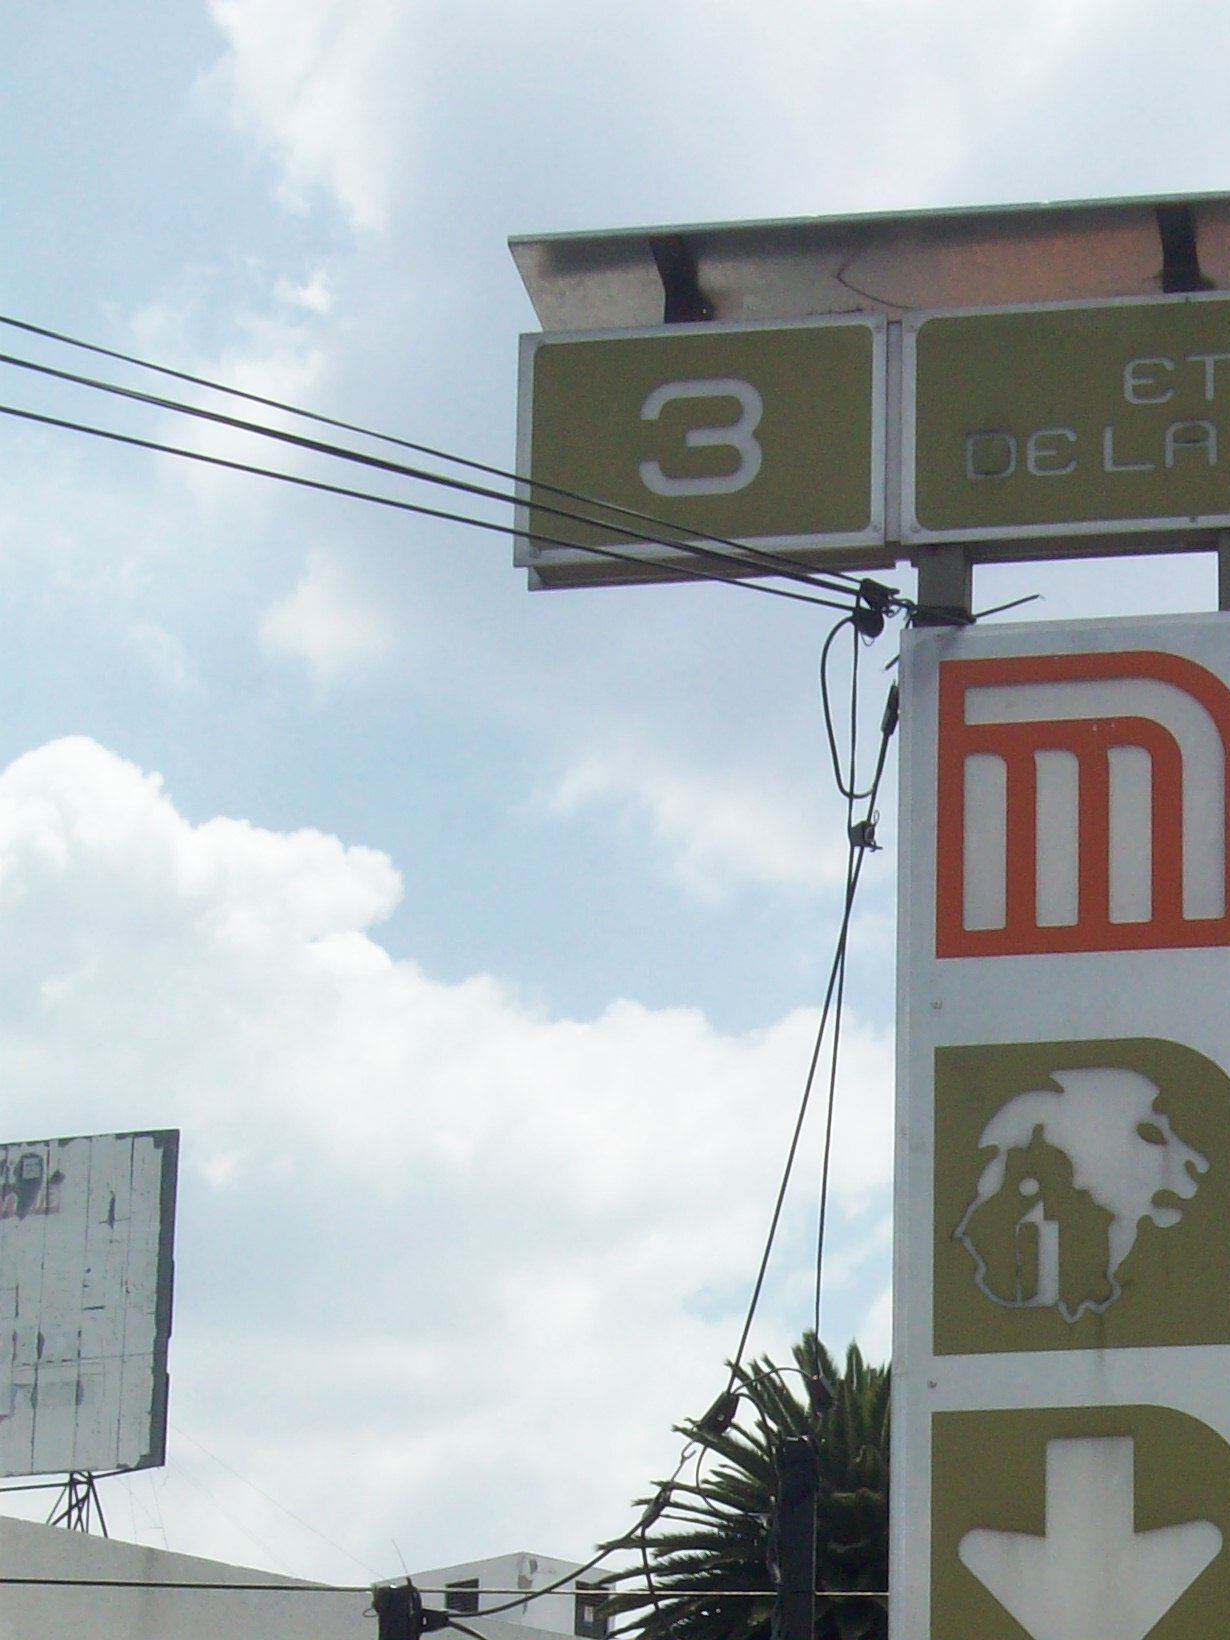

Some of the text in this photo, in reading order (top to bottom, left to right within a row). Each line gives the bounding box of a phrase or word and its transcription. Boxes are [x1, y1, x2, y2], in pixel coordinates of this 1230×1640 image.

[639, 378, 763, 497] 3
[963, 426, 1078, 480] DE
[1103, 418, 1218, 473] LA
